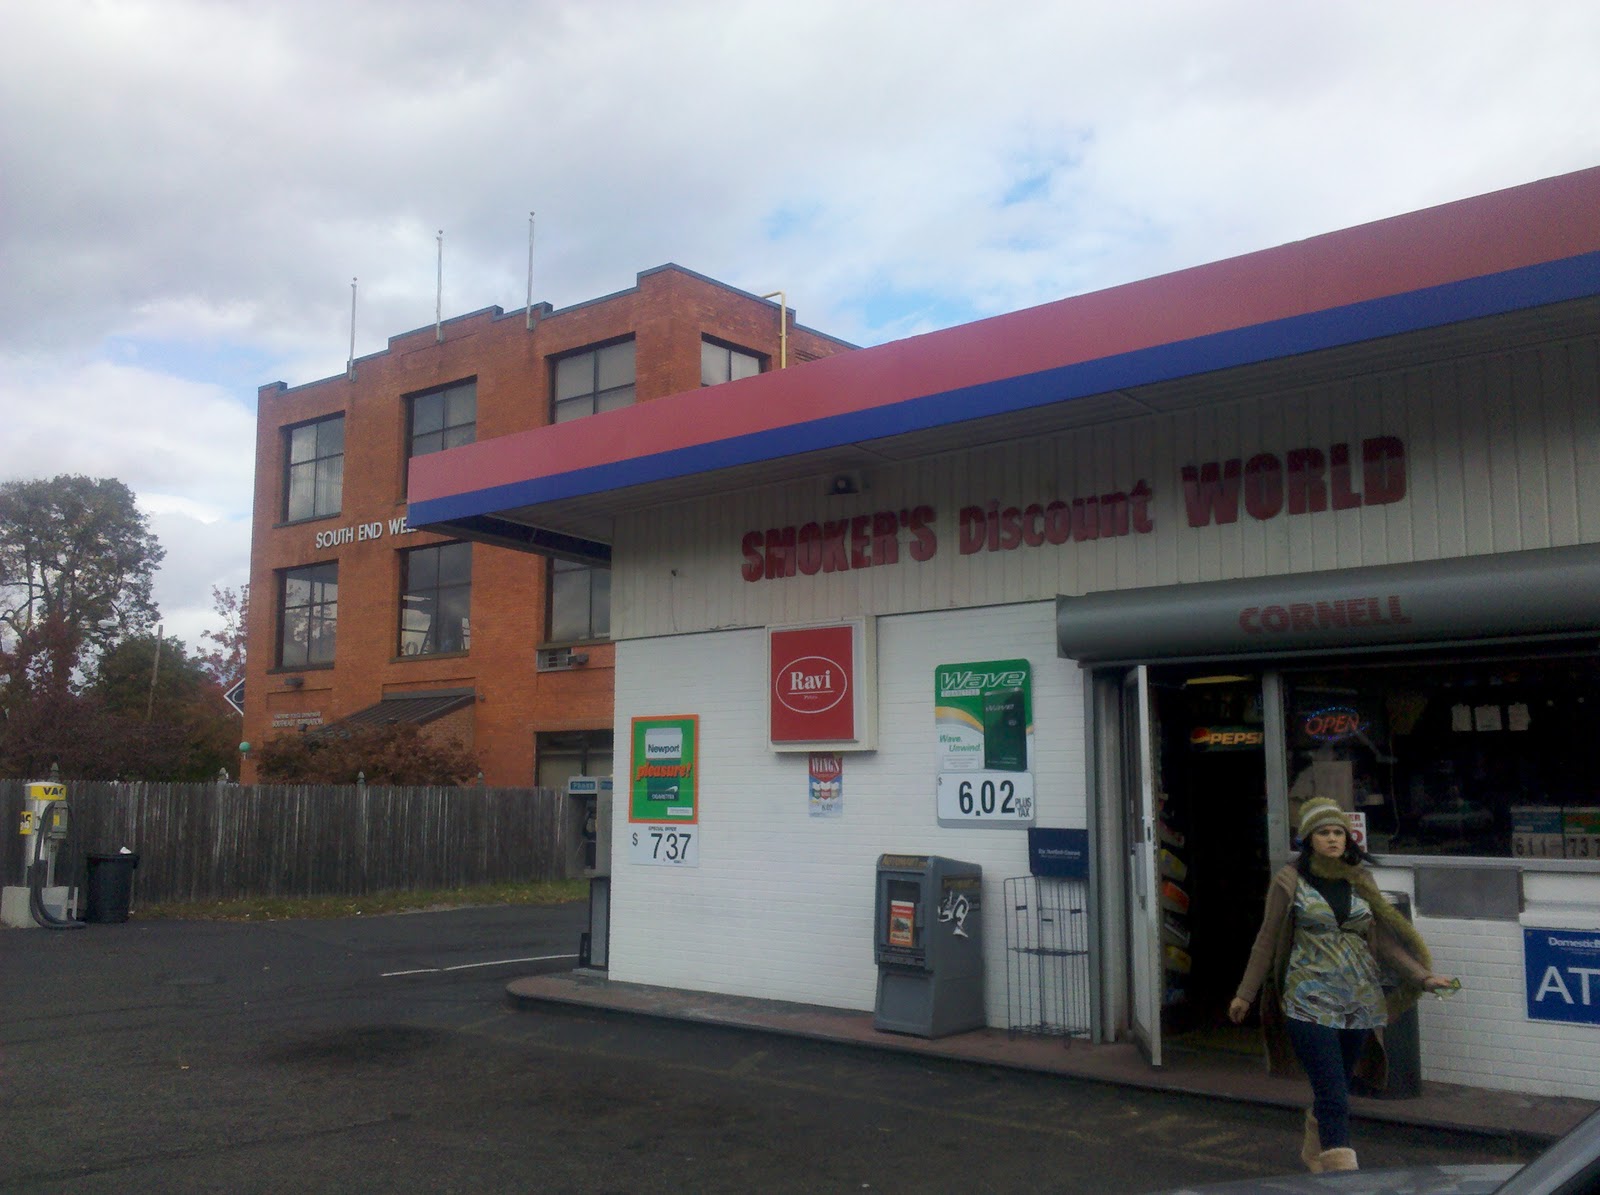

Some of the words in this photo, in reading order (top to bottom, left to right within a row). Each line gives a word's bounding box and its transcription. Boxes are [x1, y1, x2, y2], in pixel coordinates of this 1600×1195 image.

[741, 505, 937, 582] SMOKER'S
[959, 478, 1153, 556] Discount
[1181, 435, 1407, 528] WORLD
[315, 527, 354, 549] SOUTH
[358, 521, 383, 541] END
[1239, 595, 1413, 634] CORNELL
[790, 669, 832, 691] Ravi
[941, 671, 1026, 690] Wave
[1305, 714, 1359, 736] OPEN
[647, 744, 680, 754] Newport
[636, 761, 692, 782] pleasure!
[959, 780, 1015, 816] 6.02
[1015, 797, 1032, 808] PLUS
[1017, 807, 1030, 818] TAX
